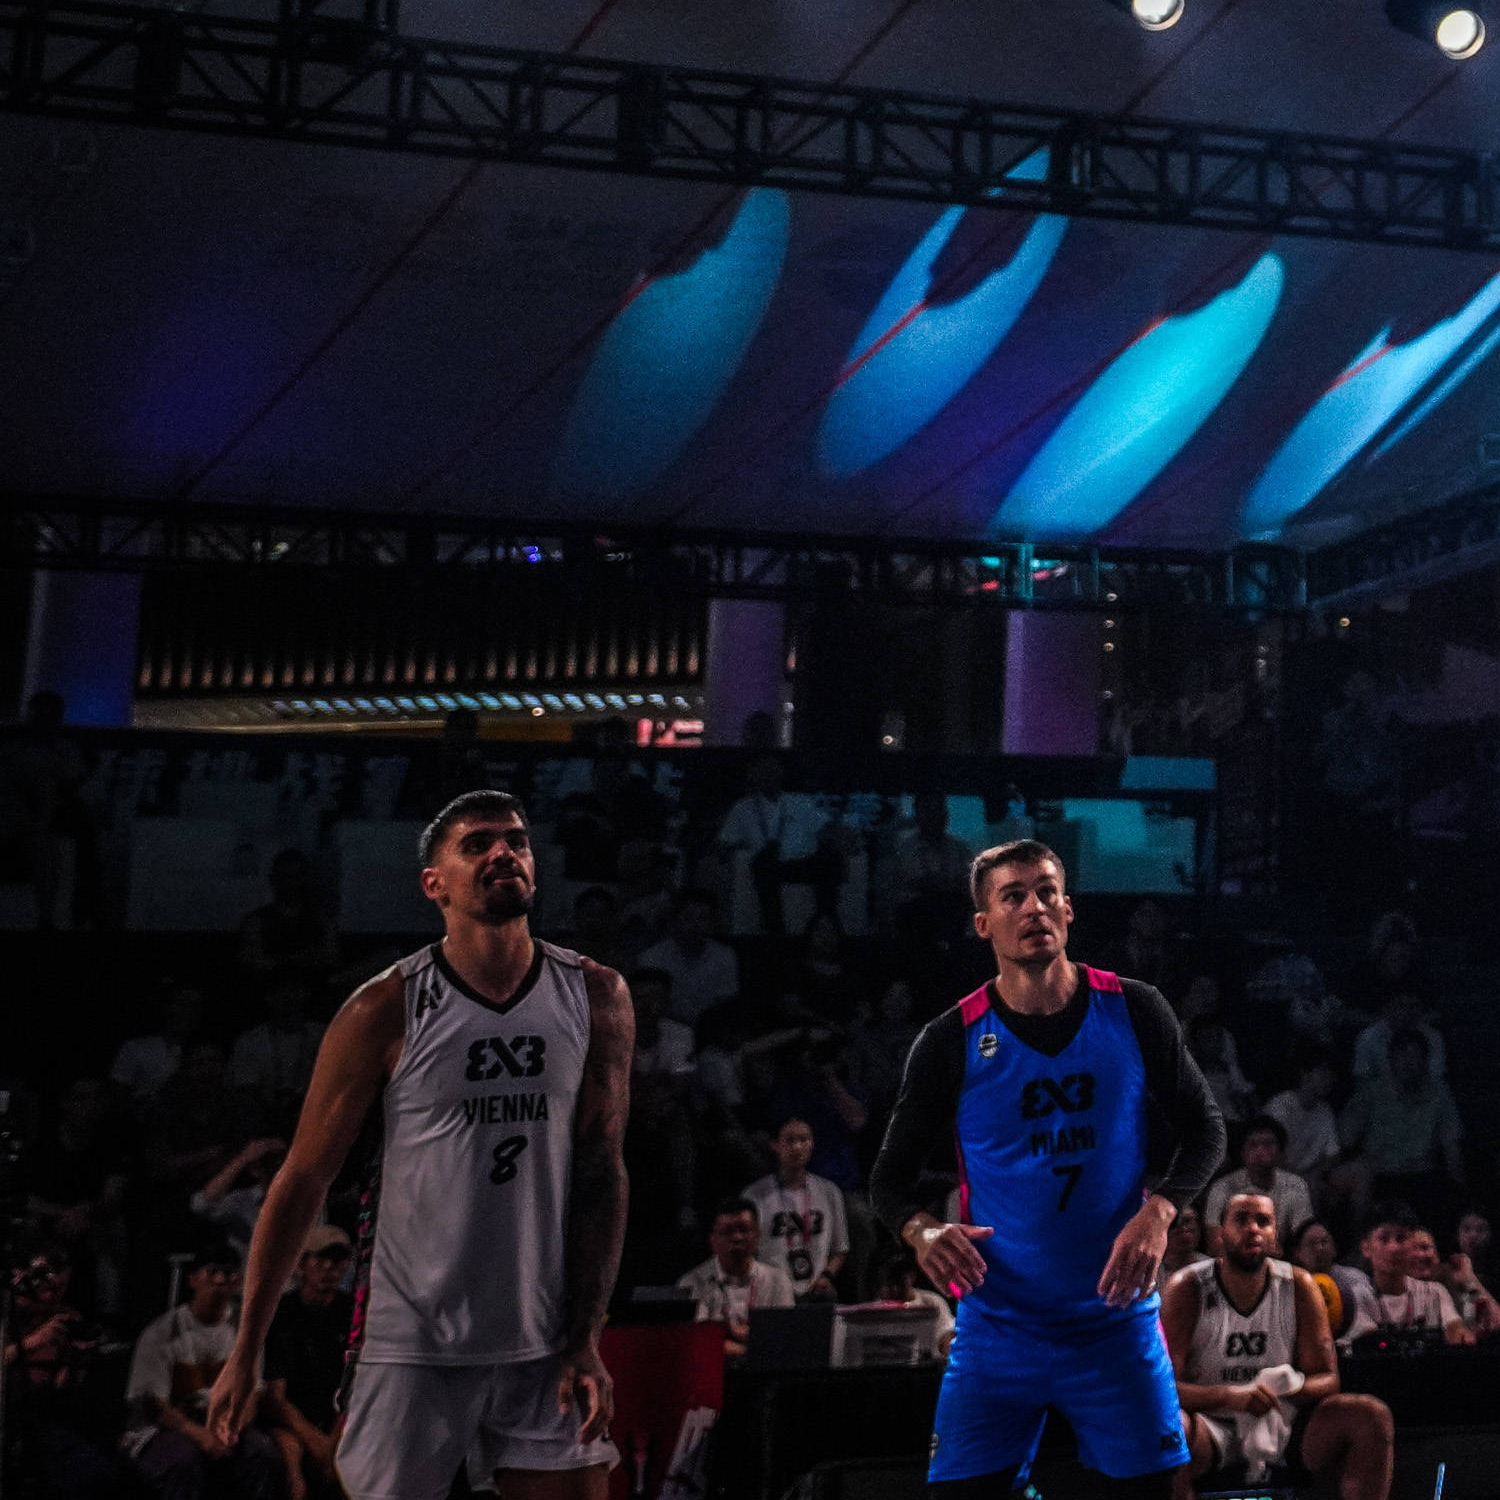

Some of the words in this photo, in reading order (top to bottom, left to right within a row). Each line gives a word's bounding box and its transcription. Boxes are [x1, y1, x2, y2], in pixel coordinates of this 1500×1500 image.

[464, 1092, 549, 1125] VIENNA
[490, 1135, 528, 1185] 8
[1031, 1124, 1096, 1157] MIAMI
[1053, 1165, 1083, 1212] 7
